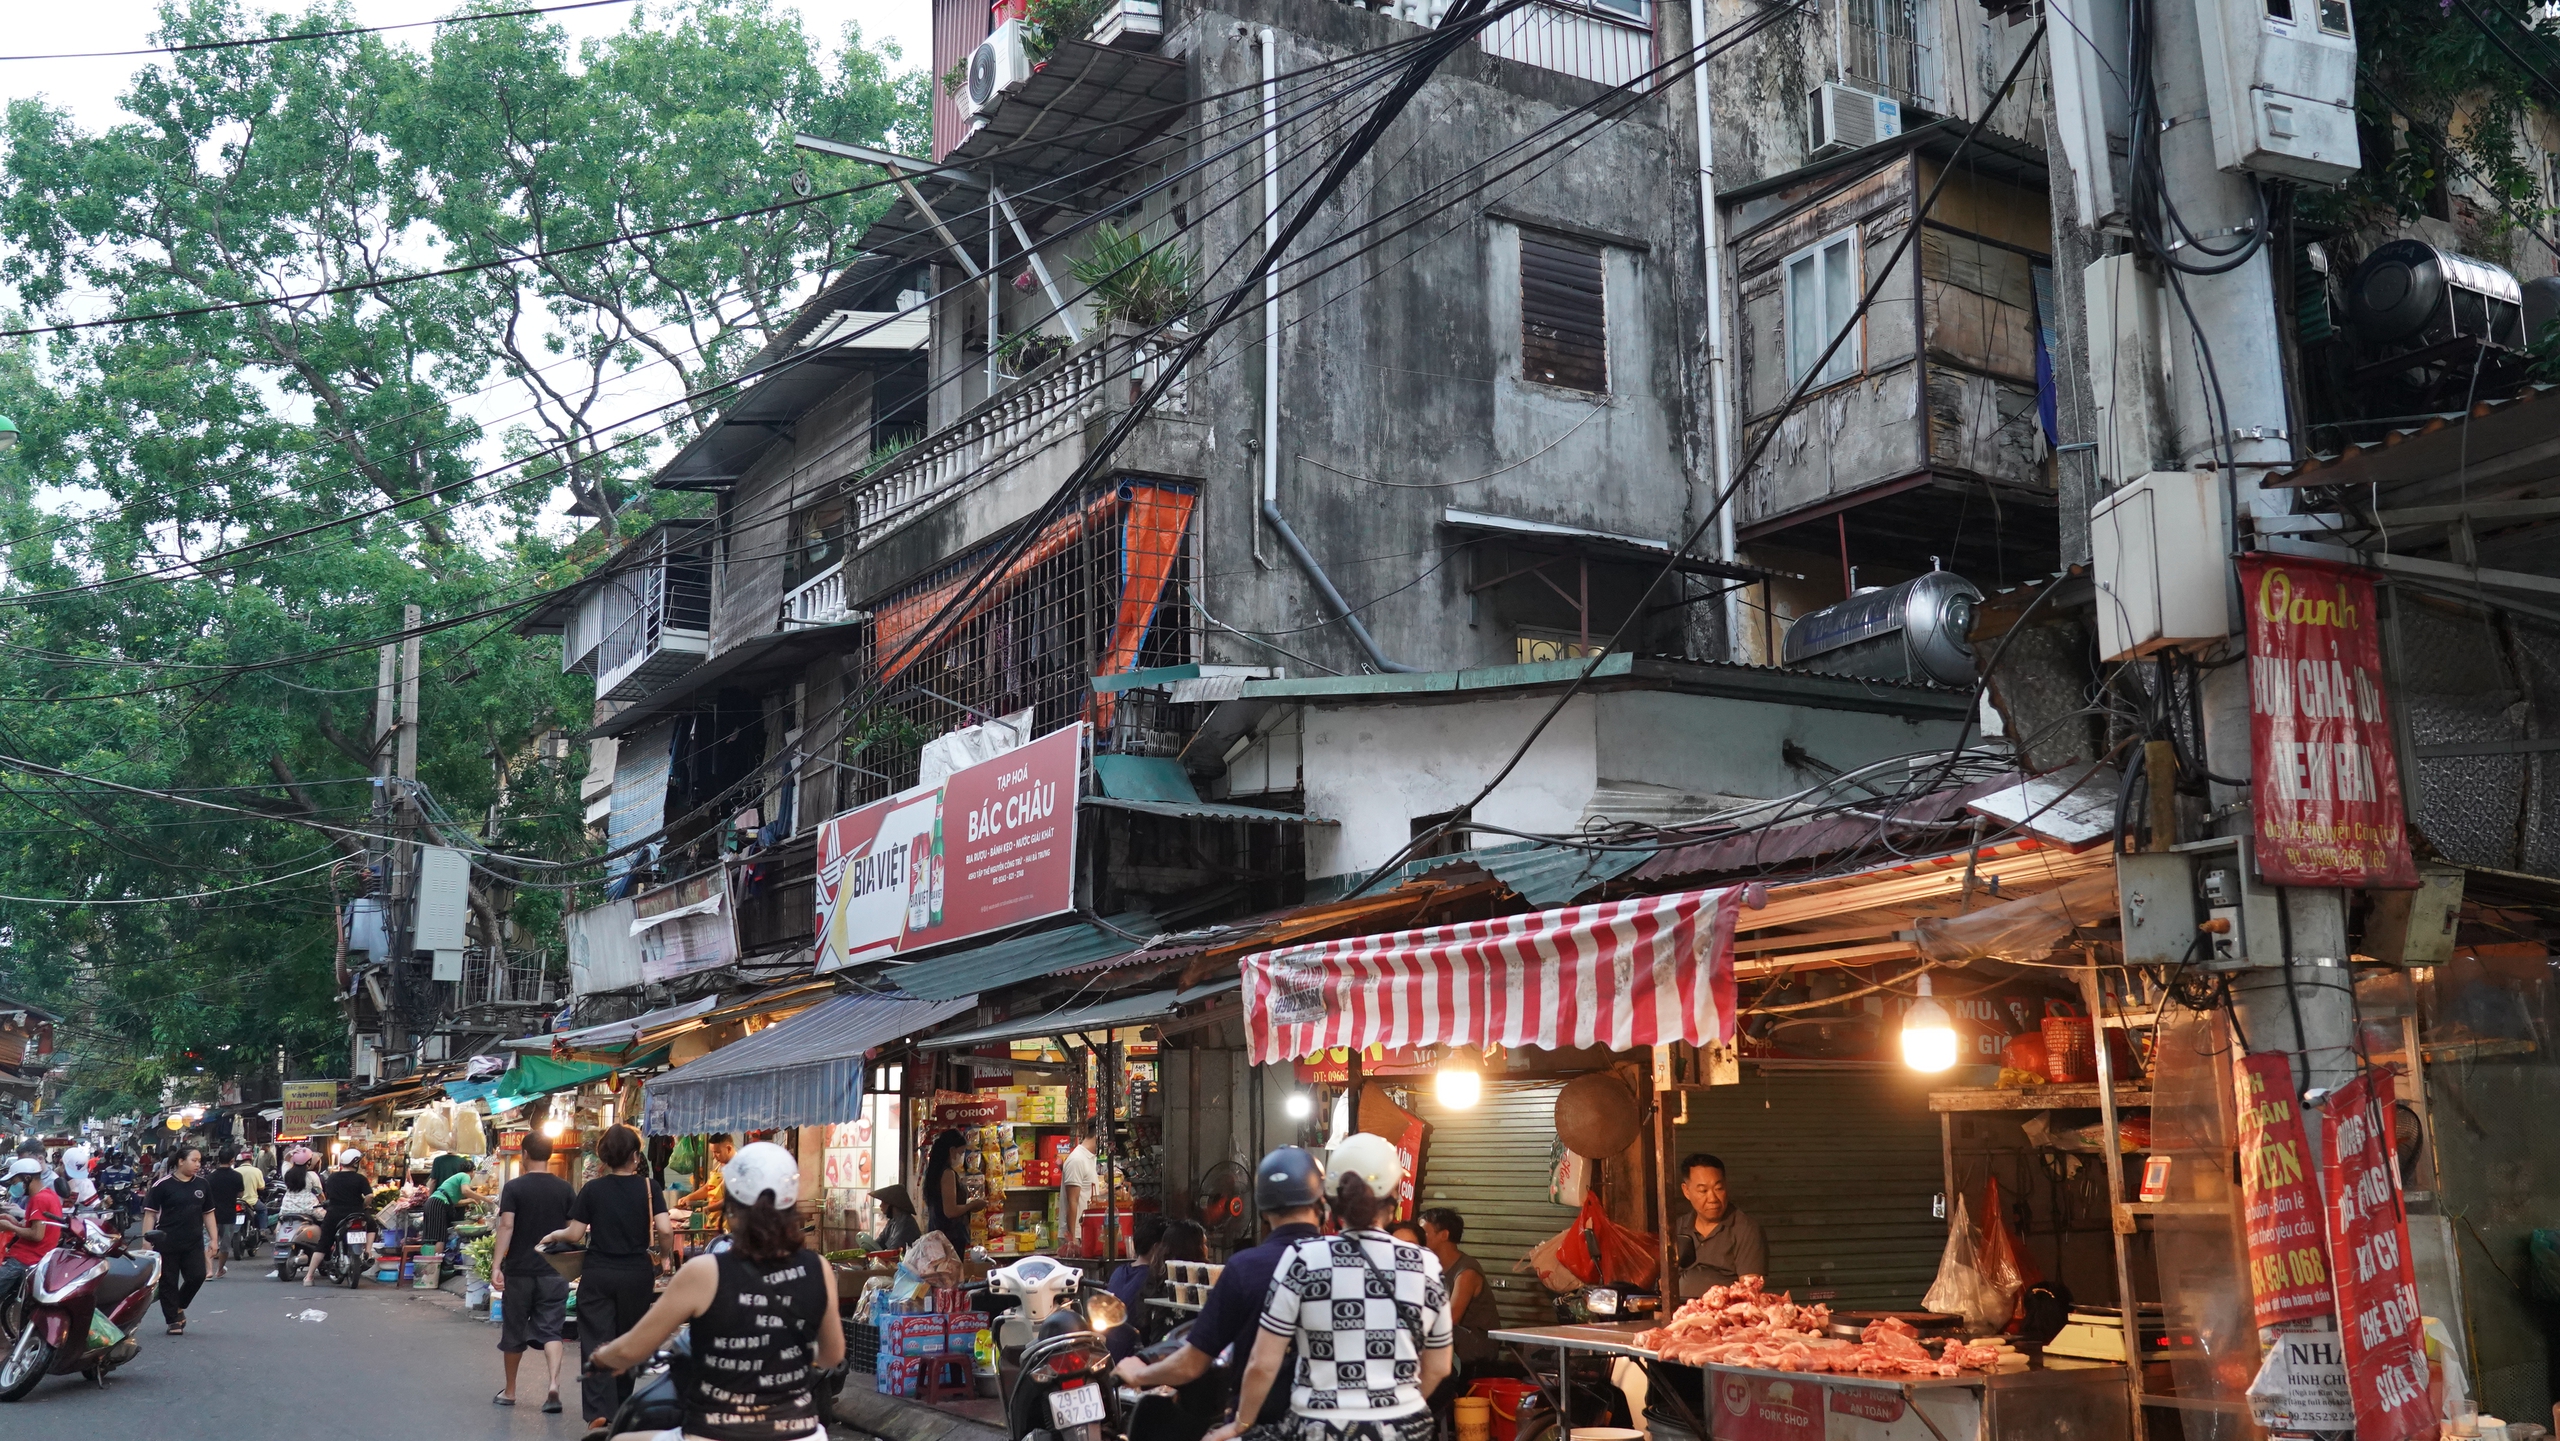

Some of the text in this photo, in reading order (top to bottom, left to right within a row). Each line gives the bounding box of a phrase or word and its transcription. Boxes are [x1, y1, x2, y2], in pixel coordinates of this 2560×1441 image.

[2260, 567, 2359, 630] Oanh
[2252, 643, 2294, 717] BÚN
[2275, 731, 2377, 803] NEM RÁN
[997, 762, 1029, 792] TẠP HOÁ
[967, 779, 1056, 843] BÁC CHÂU
[966, 853, 974, 865] BIA
[305, 1099, 334, 1111] QUAY
[959, 1107, 995, 1118] ORION
[2273, 1195, 2293, 1214] Bán
[2275, 1223, 2293, 1245] yêu
[2295, 1215, 2316, 1237] cầu
[1332, 1257, 1365, 1266] GOOD
[2263, 1247, 2326, 1292] 954 068
[2292, 1292, 2314, 1308] hàng
[2314, 1287, 2331, 1303] đầu
[1333, 1319, 1365, 1329] GOOD
[1366, 1330, 1396, 1340] GOOD
[728, 1337, 747, 1349] CAN
[718, 1357, 737, 1370] CAN
[759, 1374, 775, 1387] WE
[775, 1372, 794, 1385] CAN
[1337, 1380, 1368, 1389] GOOD
[712, 1387, 731, 1401] CAN
[1726, 1383, 1747, 1403] CP
[2376, 1363, 2418, 1413] SỮA
[2307, 1398, 2321, 1406] full
[705, 1412, 721, 1425] WE
[1057, 1402, 1100, 1426] 837.67
[1759, 1407, 1810, 1428] PORK SHOP
[1864, 1404, 1890, 1419] TOÀN
